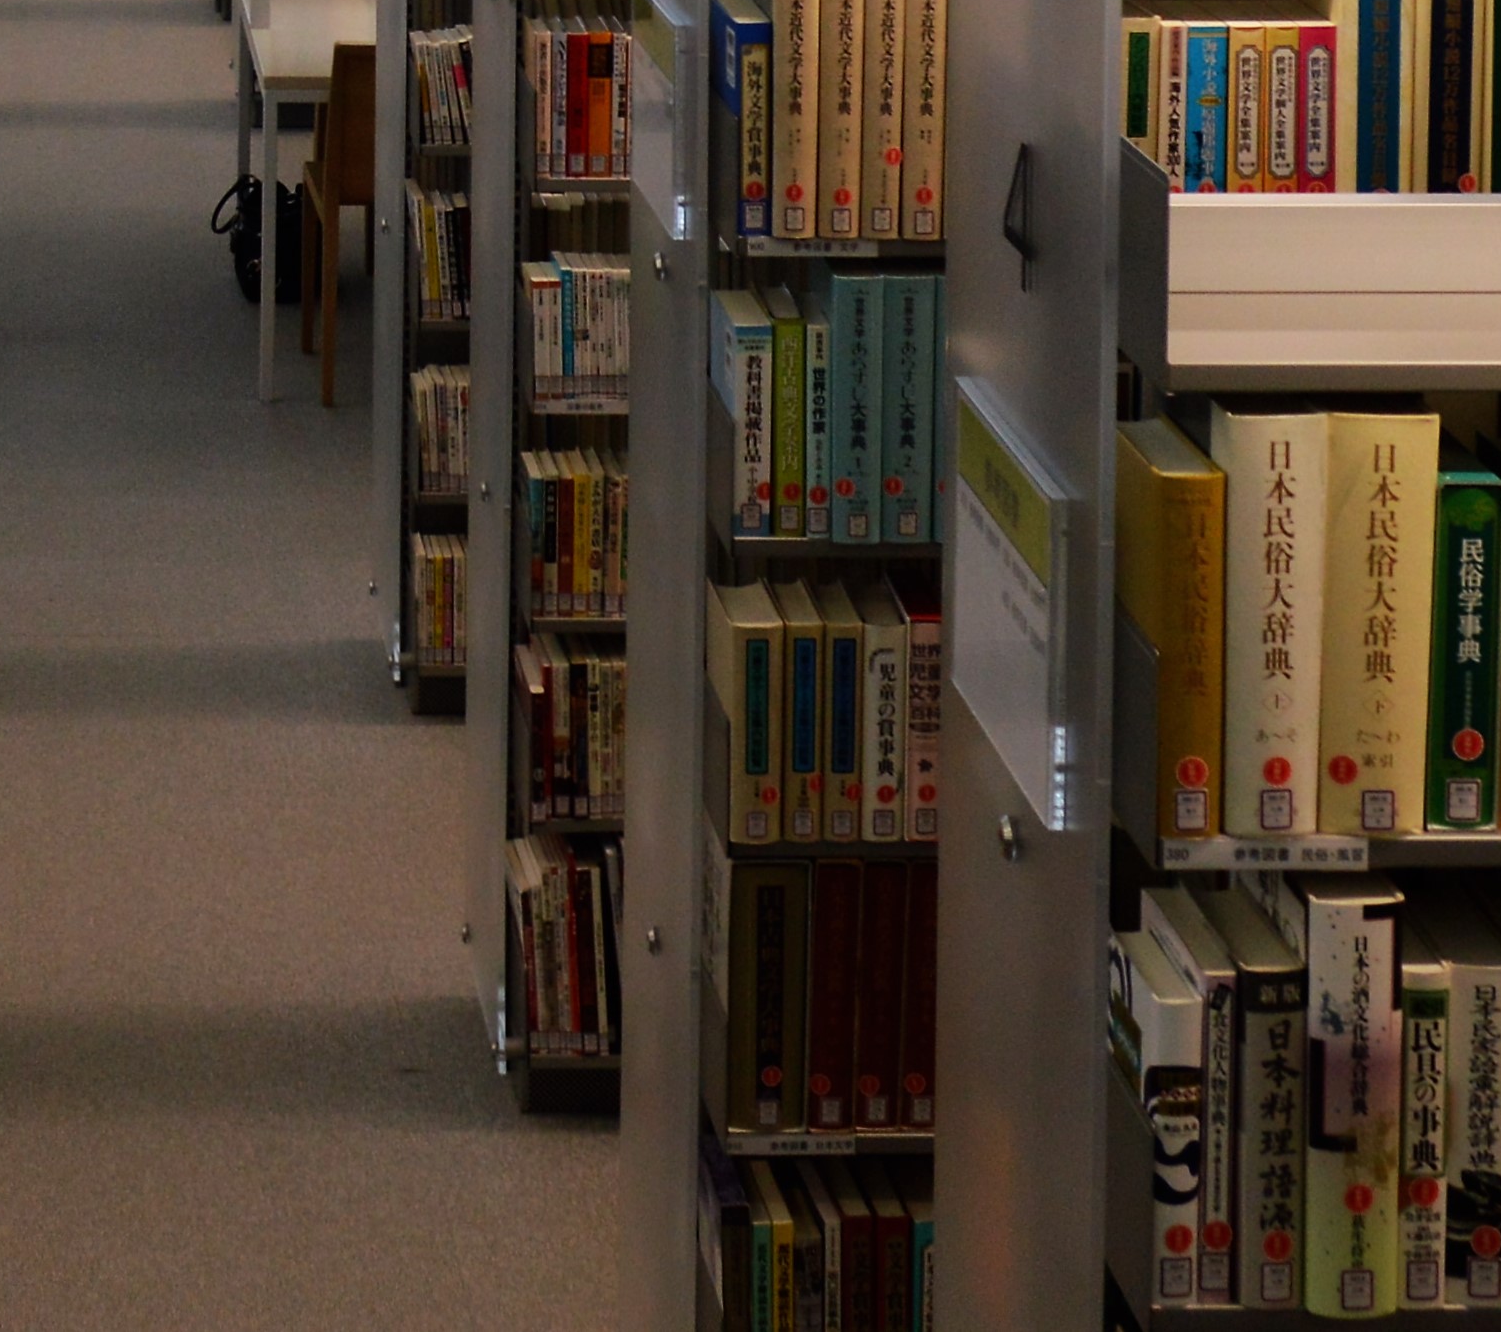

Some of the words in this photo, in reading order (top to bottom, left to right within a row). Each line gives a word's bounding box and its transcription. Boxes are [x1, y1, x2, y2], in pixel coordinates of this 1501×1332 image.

[813, 367, 826, 434] 世界の作家
[1261, 438, 1296, 682] 日本民俗大辞典
[1363, 440, 1399, 685] 日本民俗大辞典
[1458, 537, 1483, 664] 民俗学事典
[878, 663, 896, 776] 児童の賞事典
[1166, 848, 1189, 862] 380
[1233, 847, 1290, 864] 参考図書
[1260, 983, 1301, 1004] 新版
[1352, 936, 1370, 1117] 日本の酒文化総合辞典
[1412, 1020, 1442, 1171] 民具の事典
